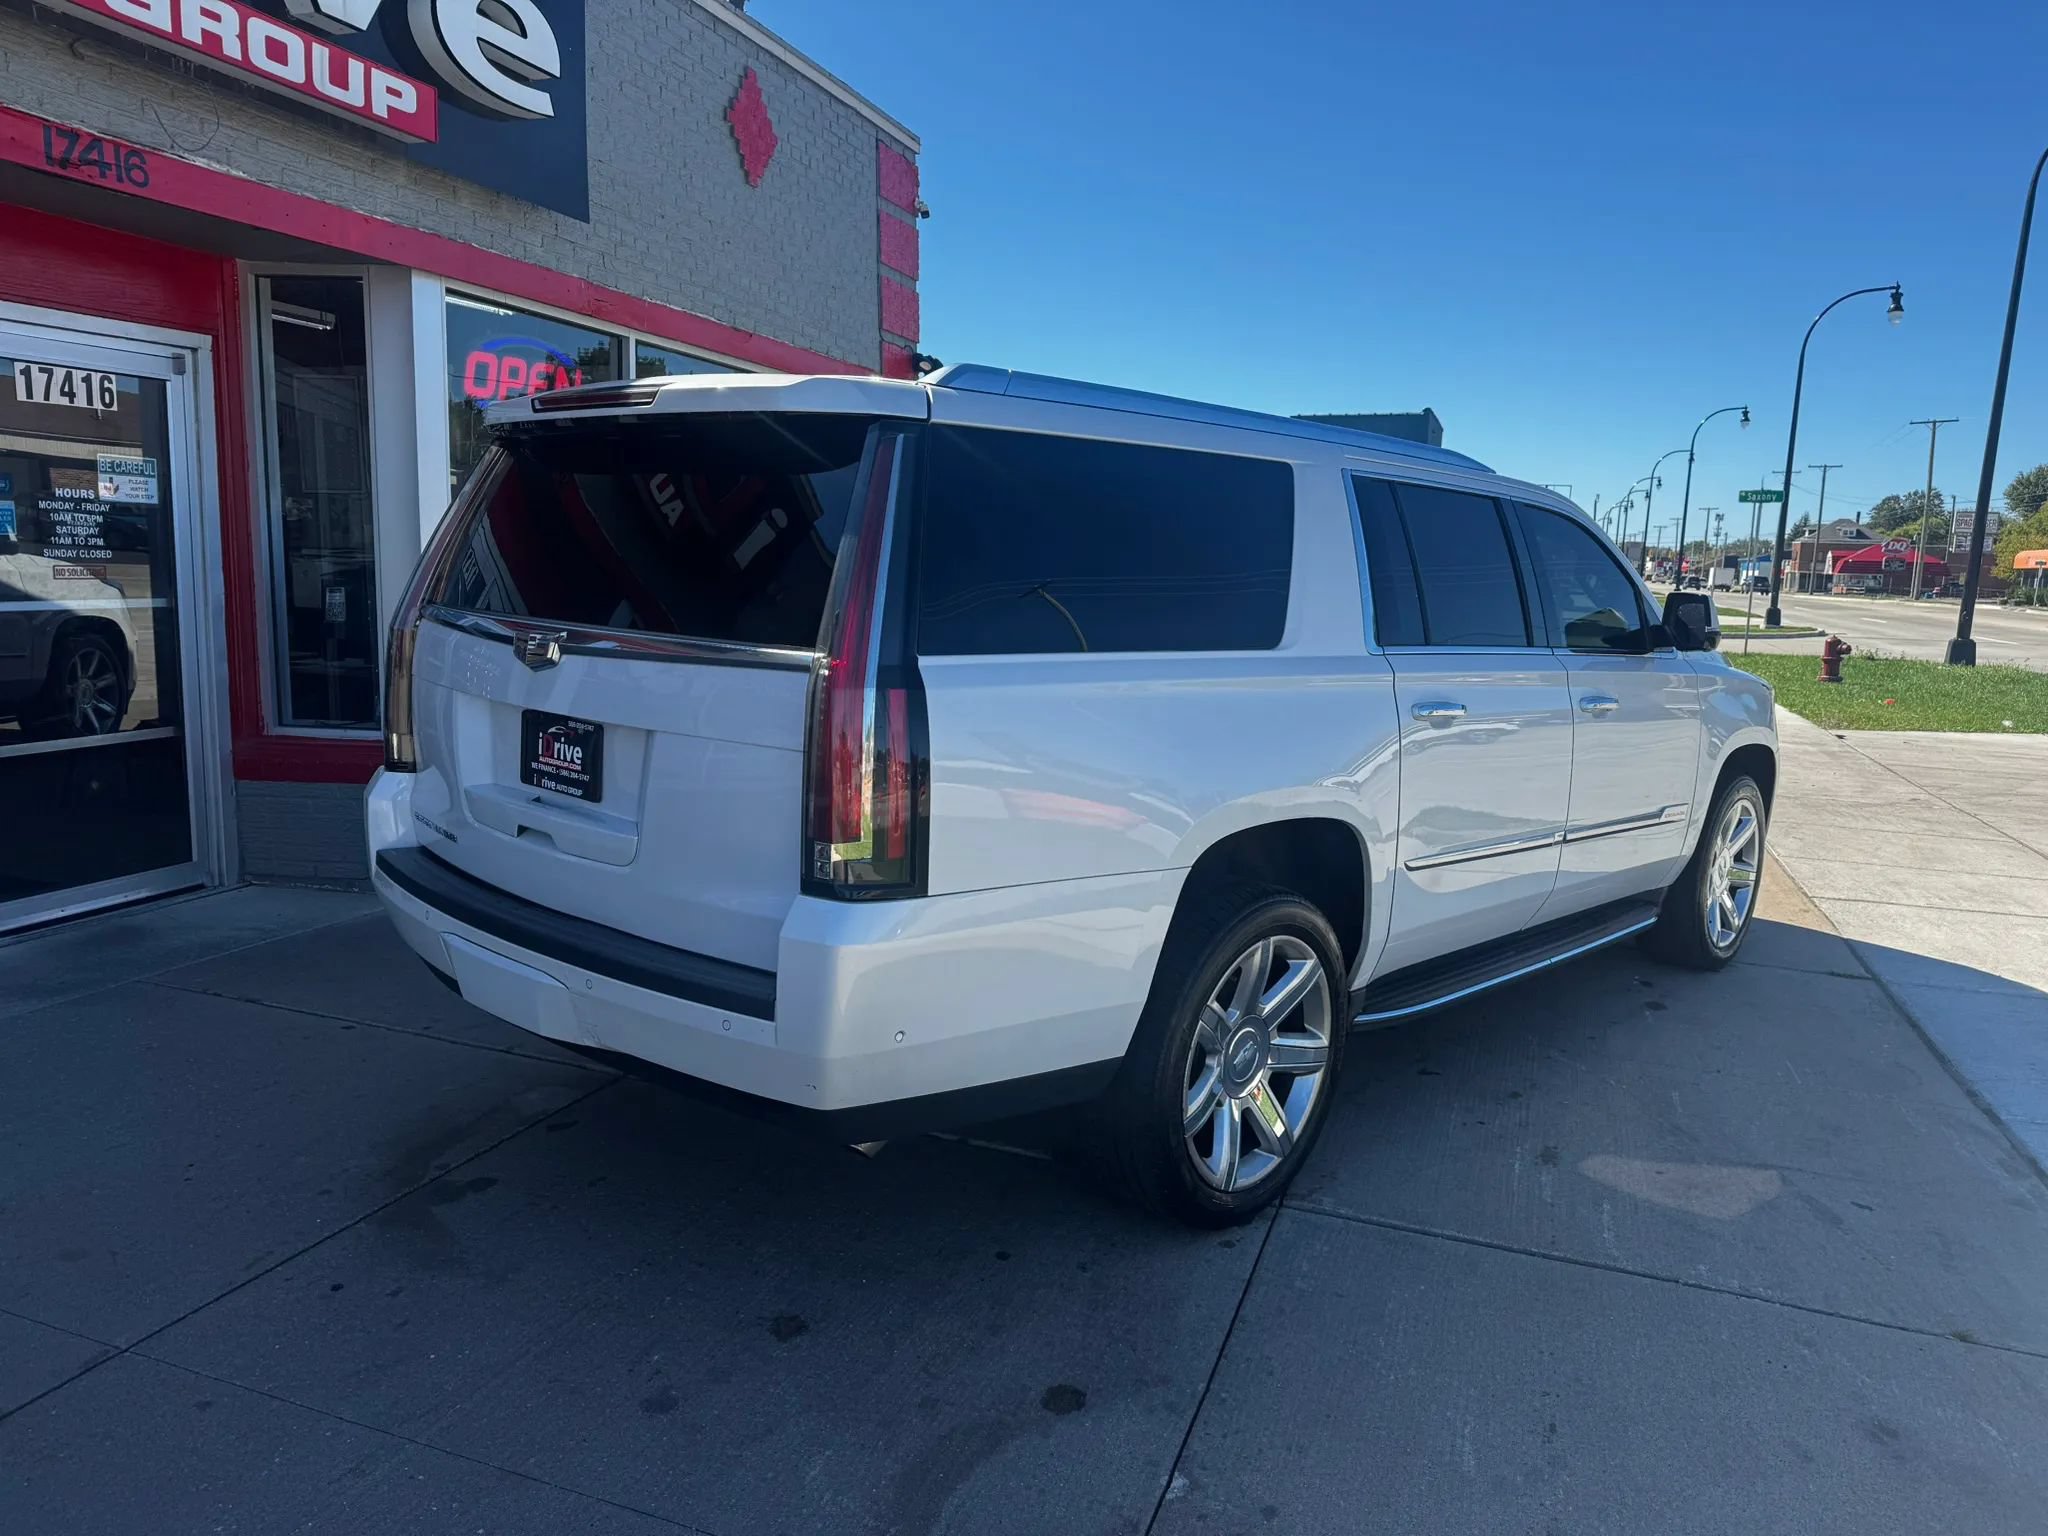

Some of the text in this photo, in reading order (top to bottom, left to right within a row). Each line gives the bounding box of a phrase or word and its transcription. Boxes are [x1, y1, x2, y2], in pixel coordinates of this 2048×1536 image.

[42, 123, 150, 189] 17416
[19, 364, 115, 409] 17416
[100, 458, 155, 475] BE CAREFUL
[55, 487, 95, 499] HOURS
[1746, 492, 1777, 501] Saxony
[38, 500, 75, 510] MONDAY
[81, 502, 111, 512] FRIDAY
[49, 512, 71, 521] 10AM
[74, 513, 85, 522] TO
[55, 525, 99, 535] SATURDAY
[50, 536, 104, 546] 11AM TO 3PM
[1888, 541, 1907, 551] DQ
[43, 548, 112, 559] SUNDAY CLOSED
[55, 568, 105, 577] NO SOLICIT
[538, 732, 583, 764] iDrive
[531, 761, 538, 770] WE
[538, 763, 557, 774] FINANCE
[533, 773, 556, 790] irive
